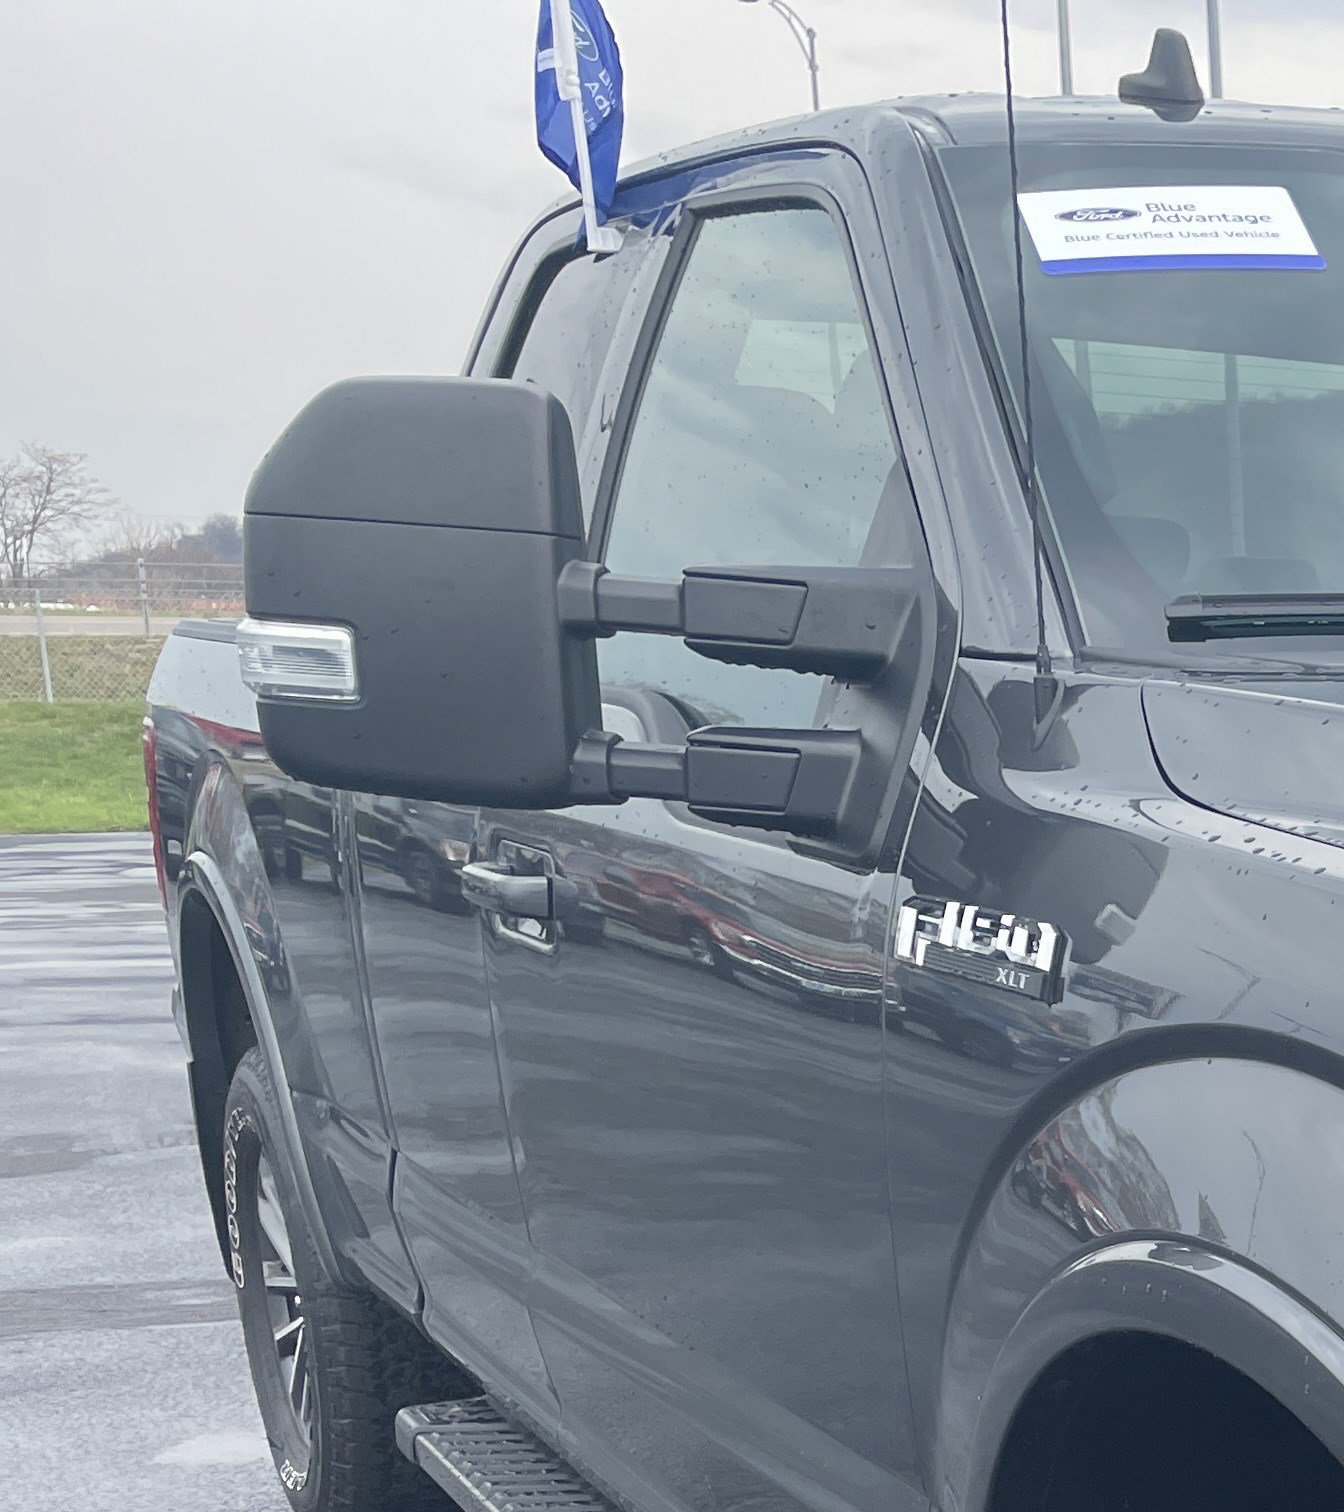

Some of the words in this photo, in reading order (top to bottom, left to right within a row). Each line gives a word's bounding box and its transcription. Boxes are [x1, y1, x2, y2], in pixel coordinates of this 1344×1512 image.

[1144, 202, 1196, 213] Blue
[1151, 213, 1273, 225] Advantage
[1064, 234, 1101, 242] Blue
[1105, 231, 1175, 241] Certified
[1178, 230, 1219, 239] Used
[1222, 230, 1281, 239] Vehicle
[994, 966, 1030, 990] XLT
